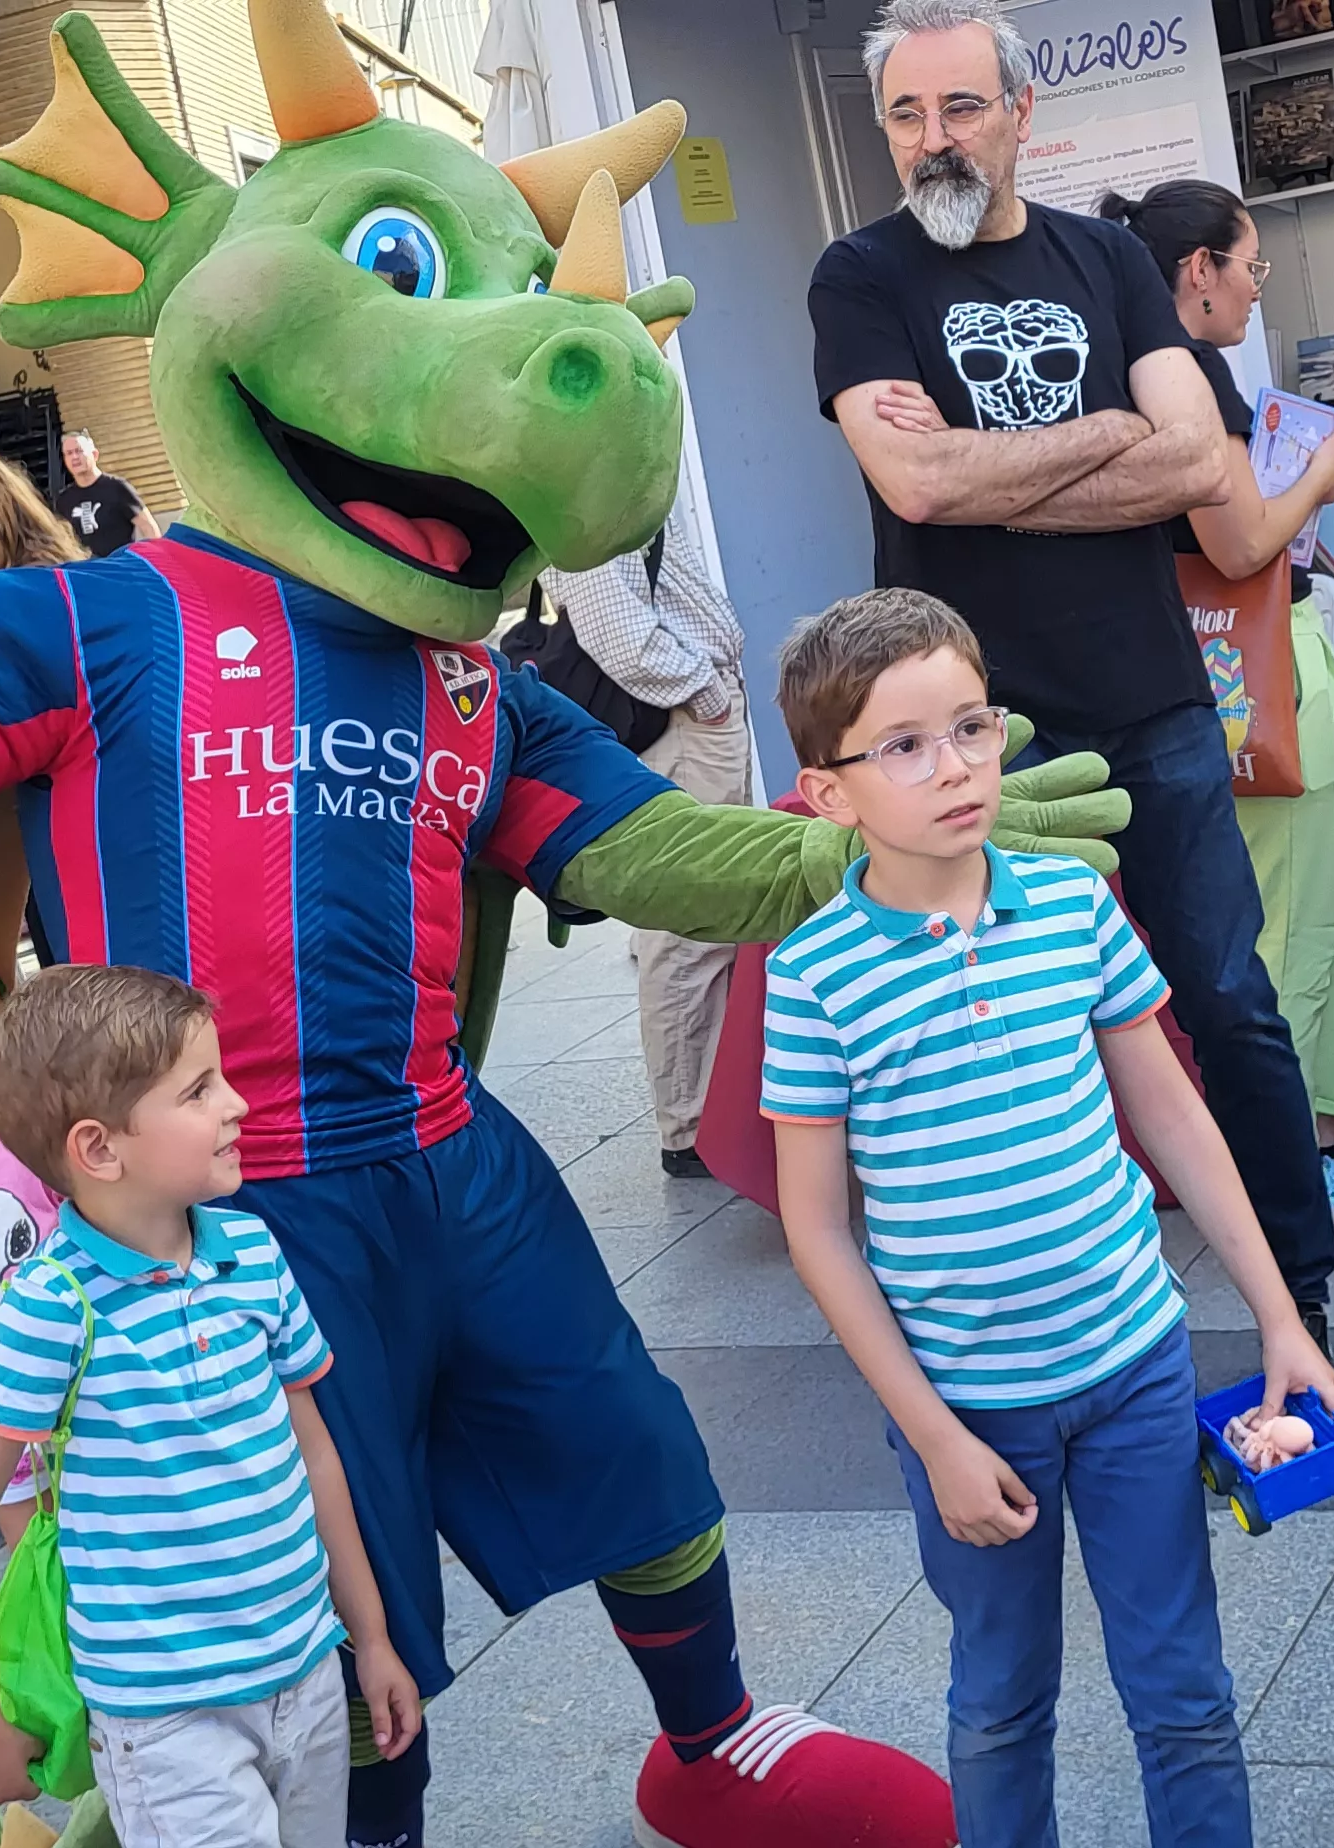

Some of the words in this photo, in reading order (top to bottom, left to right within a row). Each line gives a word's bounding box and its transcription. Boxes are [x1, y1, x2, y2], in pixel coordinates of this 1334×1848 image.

[1035, 82, 1104, 103] PROMOCIONES
[1105, 78, 1119, 89] EN
[1120, 76, 1133, 86] TU
[1134, 65, 1186, 82] COMERCIO
[1159, 138, 1194, 149] negocios
[220, 663, 262, 680] soka
